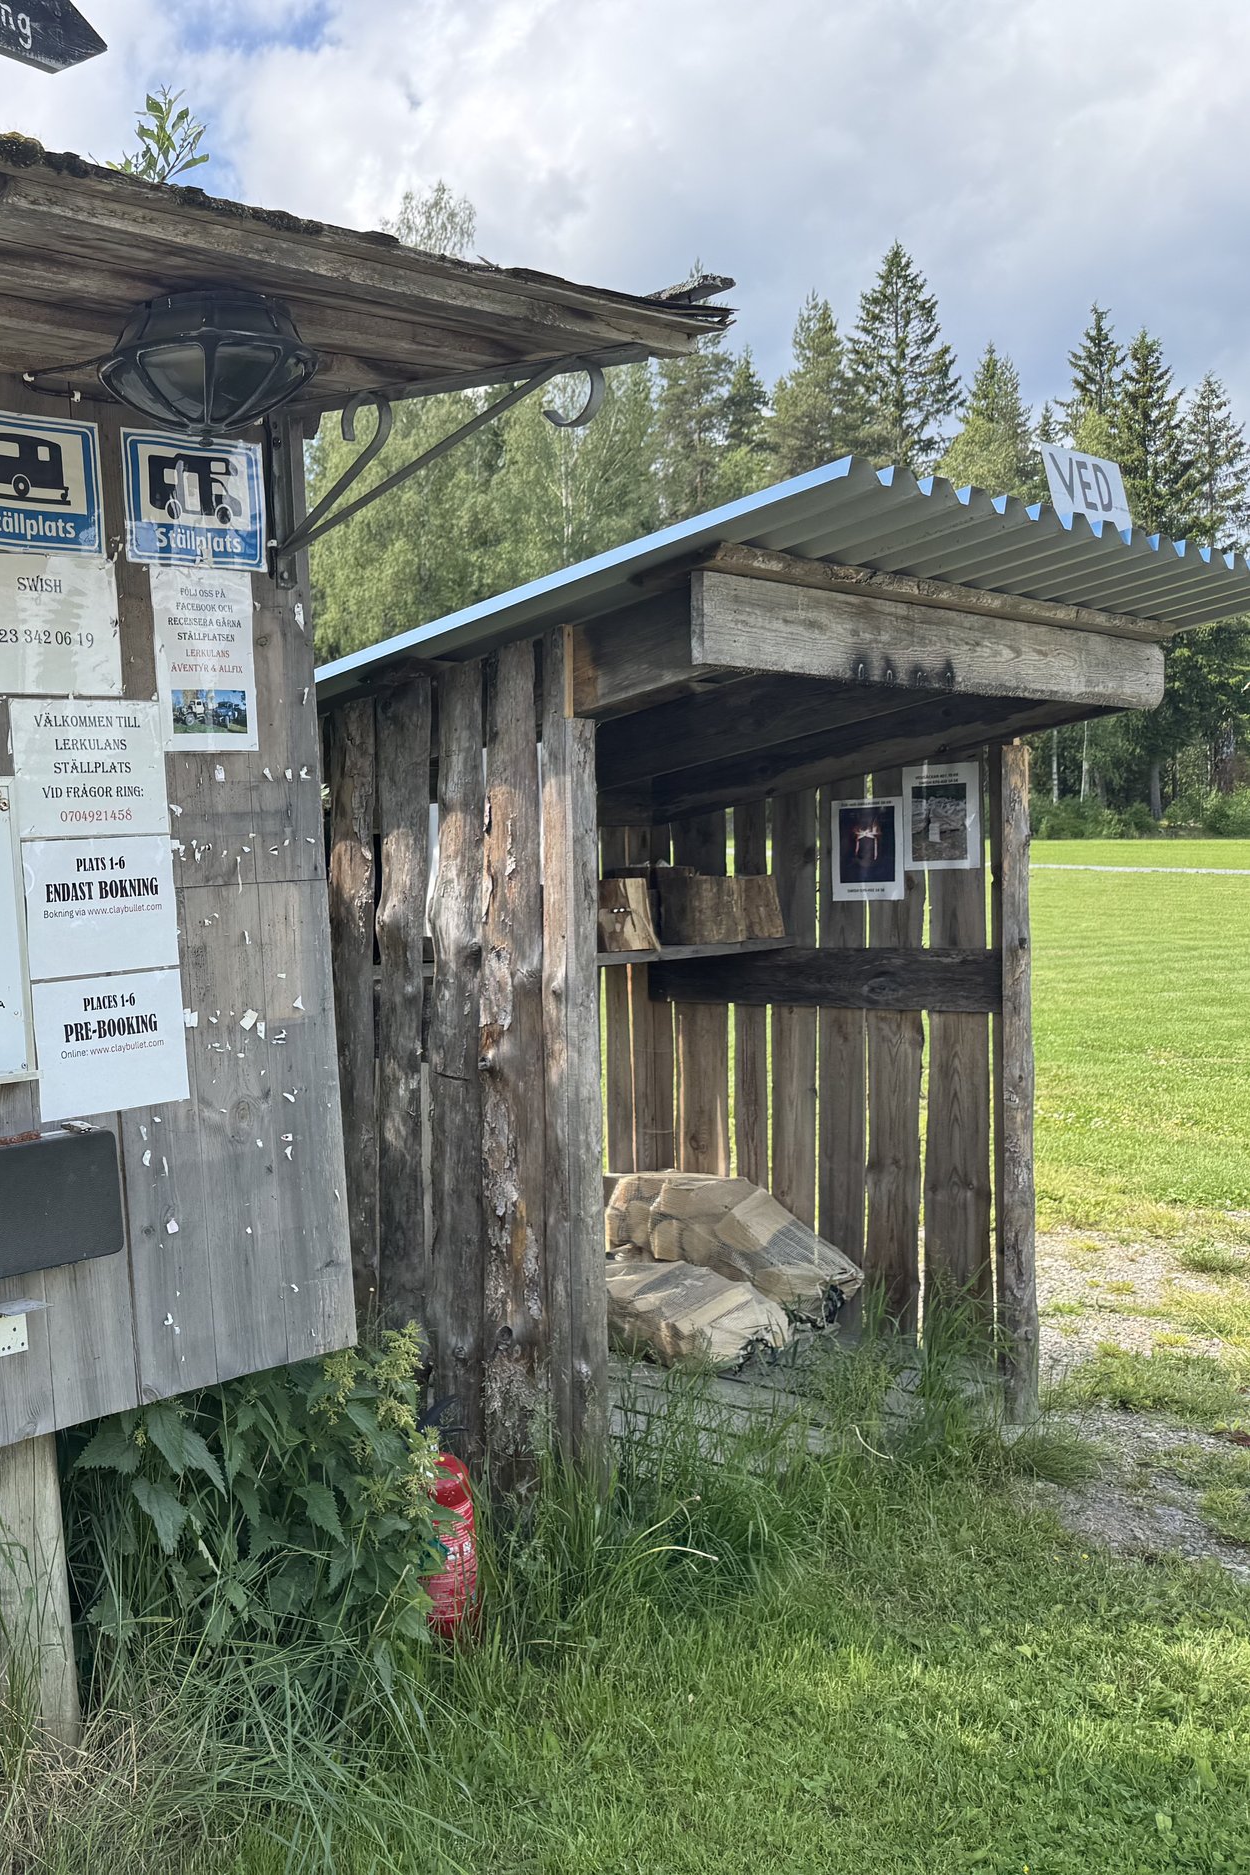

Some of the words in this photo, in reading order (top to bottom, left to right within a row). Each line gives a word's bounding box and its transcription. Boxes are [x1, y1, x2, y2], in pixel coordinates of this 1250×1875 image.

[1048, 452, 1113, 512] VED
[157, 527, 242, 553] Ställplats
[17, 575, 62, 594] SWISH
[176, 602, 217, 612] FACEBOOK
[24, 629, 52, 645] 342
[55, 631, 72, 646] 06
[77, 632, 94, 649] 19
[185, 648, 230, 659] LERKULANS
[34, 712, 113, 728] VÄLKOMMEN
[116, 716, 141, 728] TILL
[55, 738, 127, 751] LERKULANS
[53, 759, 132, 774] STÄLLPLATS
[42, 785, 63, 799] VID
[66, 783, 113, 798] FRÅGOR
[116, 785, 144, 798] RING:
[60, 807, 133, 823] 0704921458
[76, 856, 107, 872] PLATS
[109, 855, 126, 870] 1-6
[45, 881, 94, 903] ENDAST
[98, 877, 159, 900] BOKNING
[43, 909, 74, 919] Bokning
[75, 908, 86, 917] via
[87, 902, 163, 916] www.claybullet.com
[83, 994, 118, 1012] PLACES
[120, 992, 136, 1007] 1-6
[63, 1013, 158, 1043] PRE-BOOKING
[60, 1047, 89, 1060] Online:
[89, 1038, 165, 1056] www.claybullet.com
